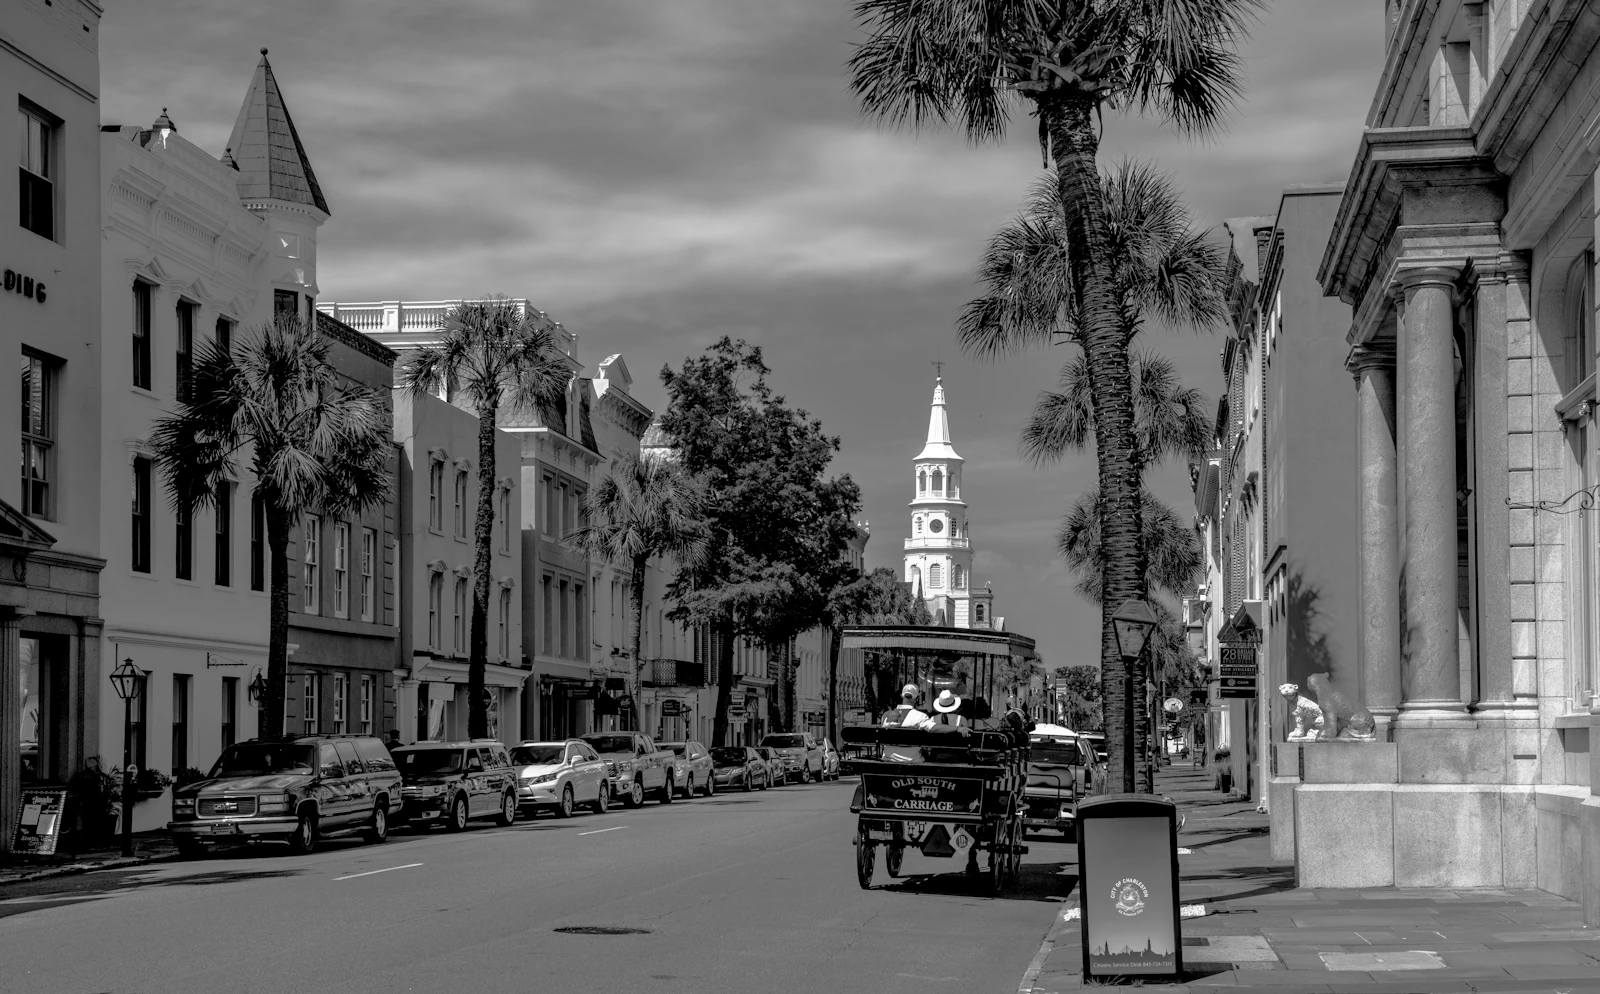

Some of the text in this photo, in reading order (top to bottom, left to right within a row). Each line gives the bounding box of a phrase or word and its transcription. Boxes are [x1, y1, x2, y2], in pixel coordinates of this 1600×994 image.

[0, 269, 46, 303] DING
[1222, 649, 1237, 660] 28
[892, 777, 957, 791] OLD SOUTH
[894, 799, 954, 811] CARRIAGE
[1115, 880, 1122, 888] OF
[1122, 878, 1149, 898] CHARLESTON
